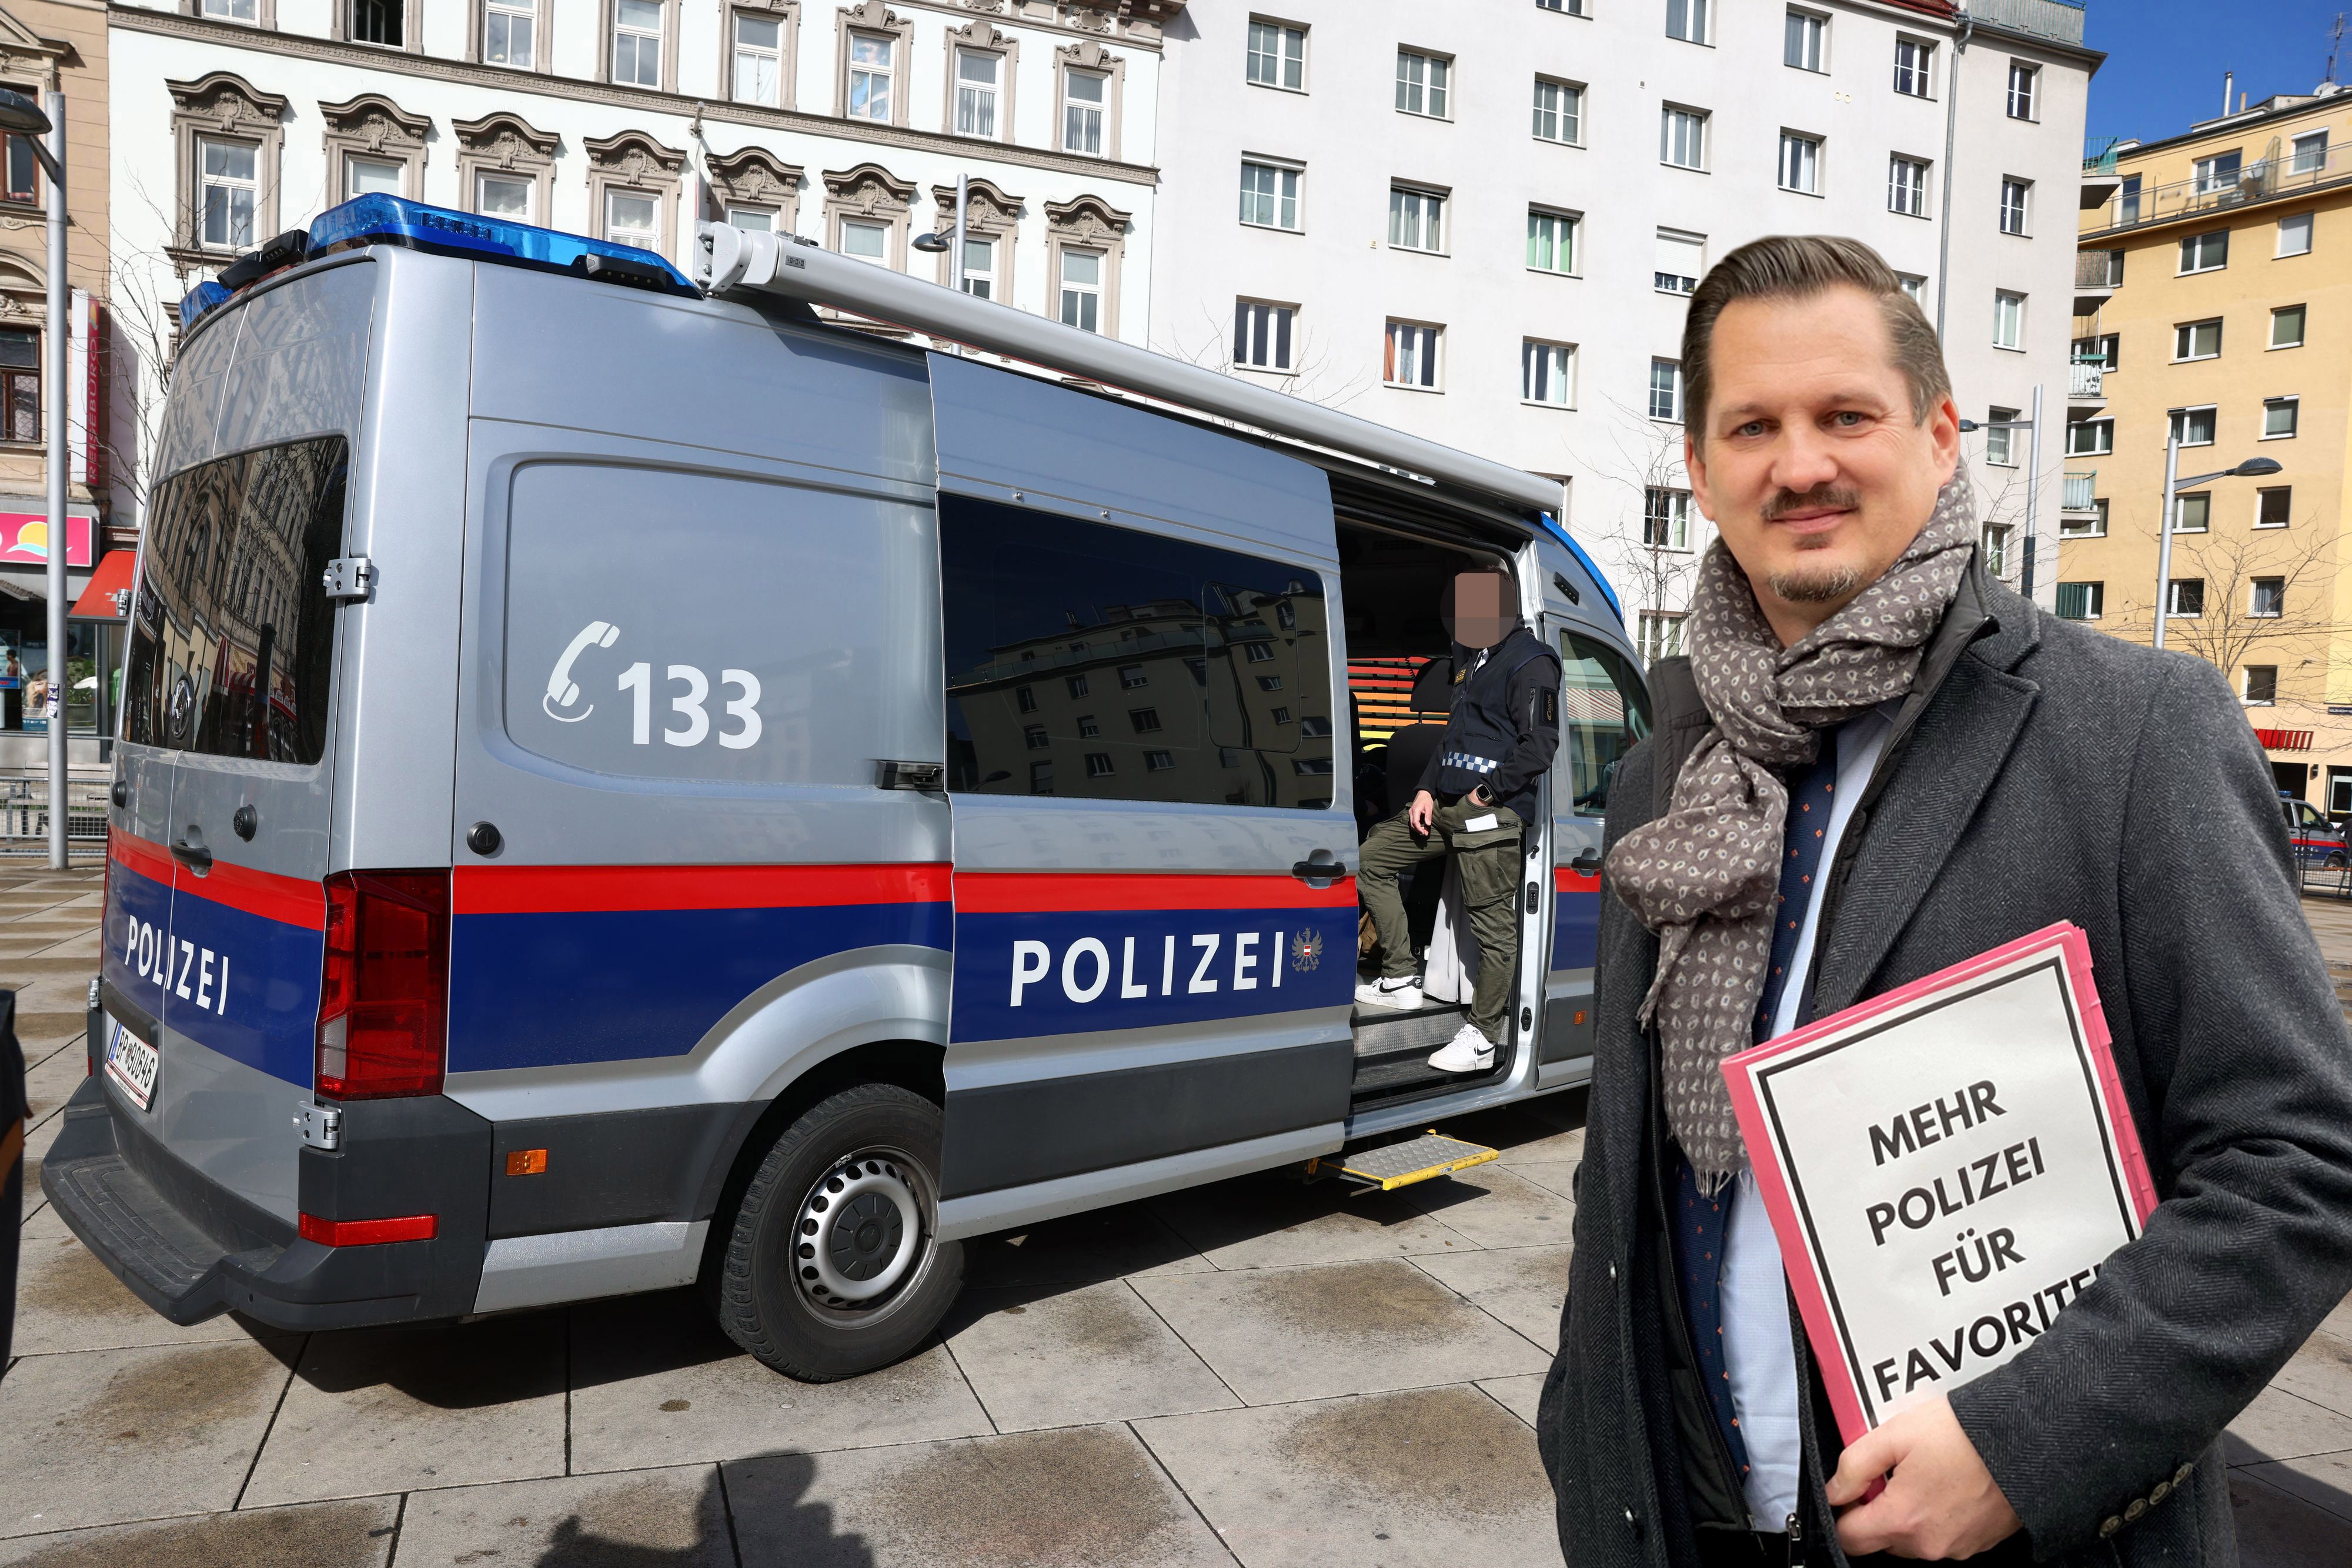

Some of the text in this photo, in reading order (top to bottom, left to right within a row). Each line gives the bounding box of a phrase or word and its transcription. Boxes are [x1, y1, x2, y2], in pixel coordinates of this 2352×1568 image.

[88, 337, 98, 480] REISEBÜRO
[618, 662, 762, 750] 133
[124, 915, 229, 1016] POLIZEI
[1010, 931, 1284, 1007] POLIZEI
[116, 1031, 129, 1063] BP
[127, 1042, 155, 1089] 90646
[1868, 1080, 2007, 1166] MEHR
[1866, 1136, 2045, 1246] POLIZEI
[1931, 1228, 2026, 1296] FÜR
[1872, 1263, 2102, 1403] FAVORIT
